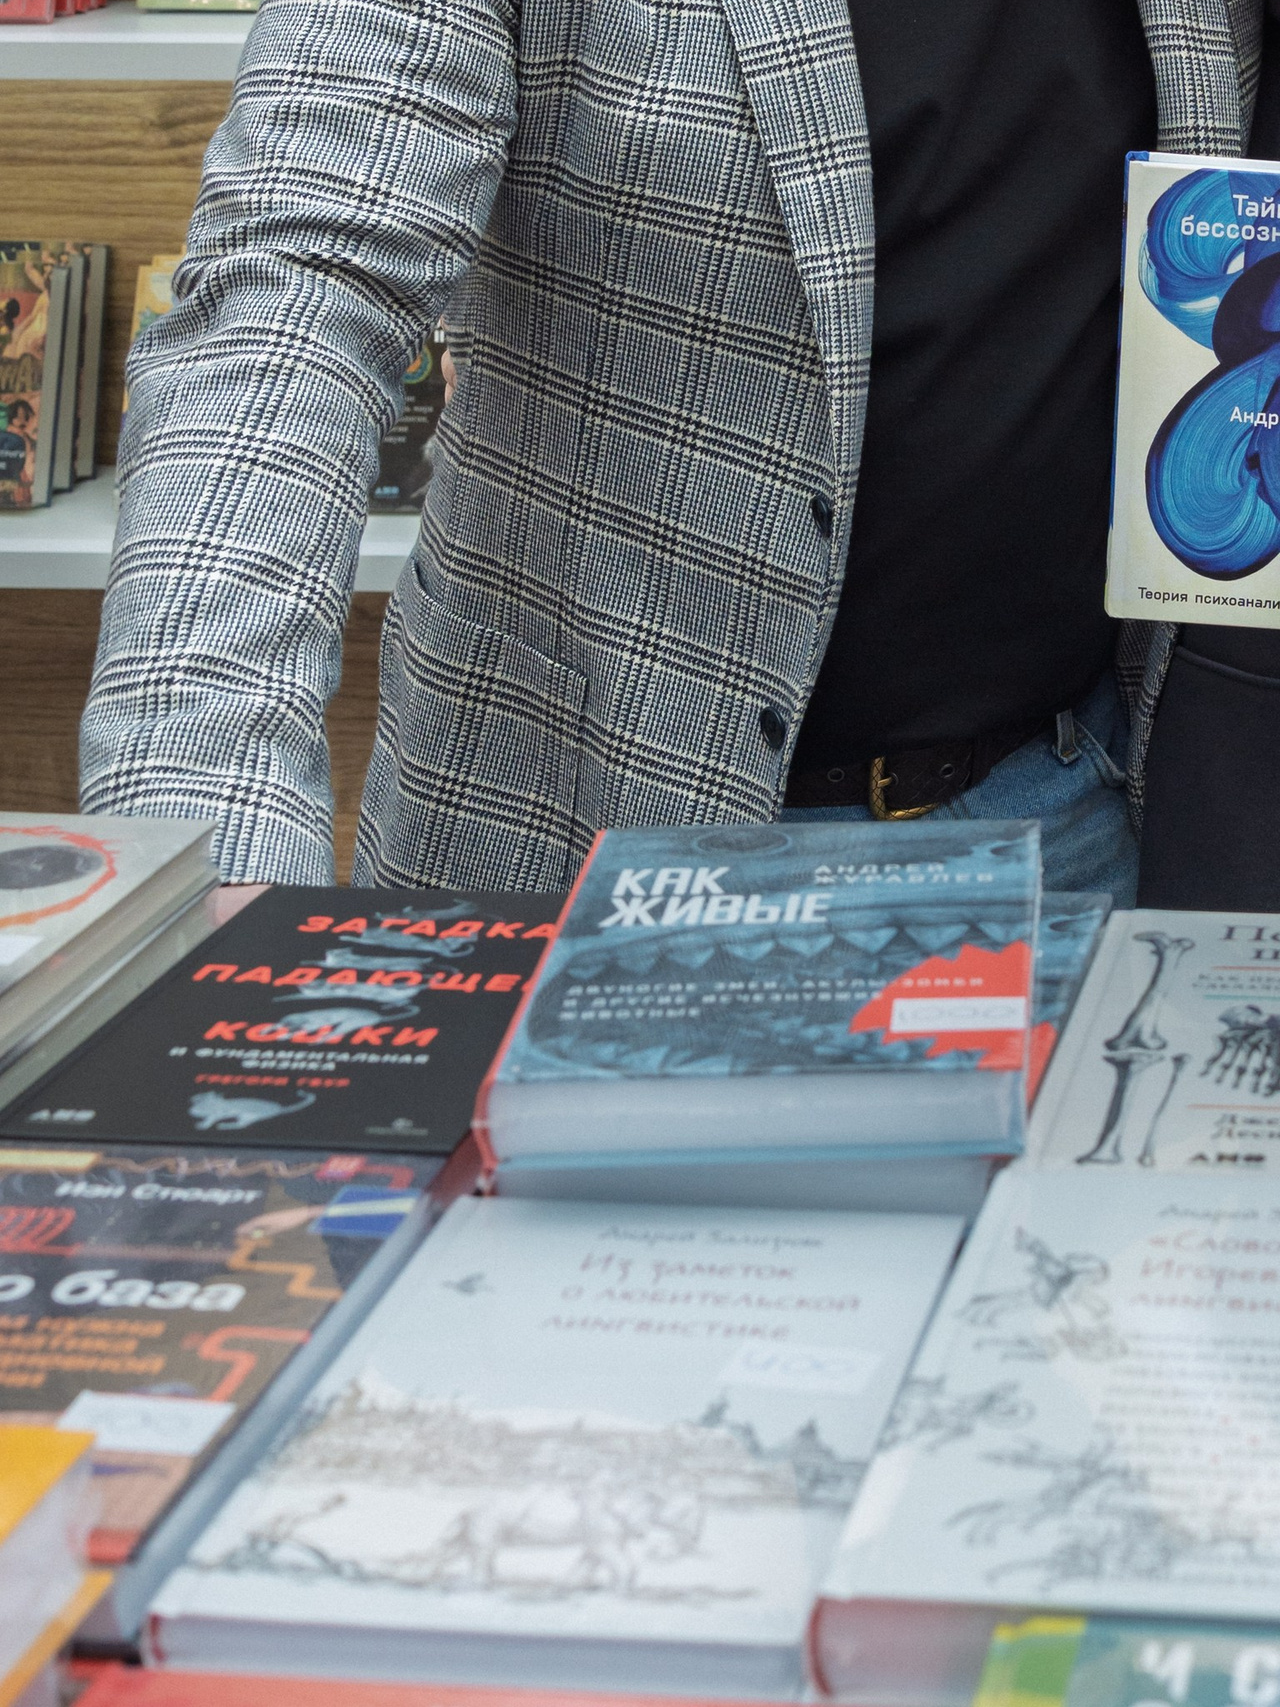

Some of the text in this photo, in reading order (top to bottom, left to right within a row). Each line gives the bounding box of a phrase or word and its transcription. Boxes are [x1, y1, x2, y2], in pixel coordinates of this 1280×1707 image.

[1137, 586, 1189, 608] Теория
[611, 865, 731, 896] КАК
[813, 872, 995, 886] ЖУРАВЛЕВ
[814, 862, 947, 875] АНДРЕЙ
[599, 892, 835, 929] ЖИВЫЕ
[297, 915, 557, 940] ЗАГАДКА
[192, 963, 534, 994] ПАДАЮЩЕ
[204, 1020, 439, 1048] КОШКИ
[51, 1268, 247, 1312] база
